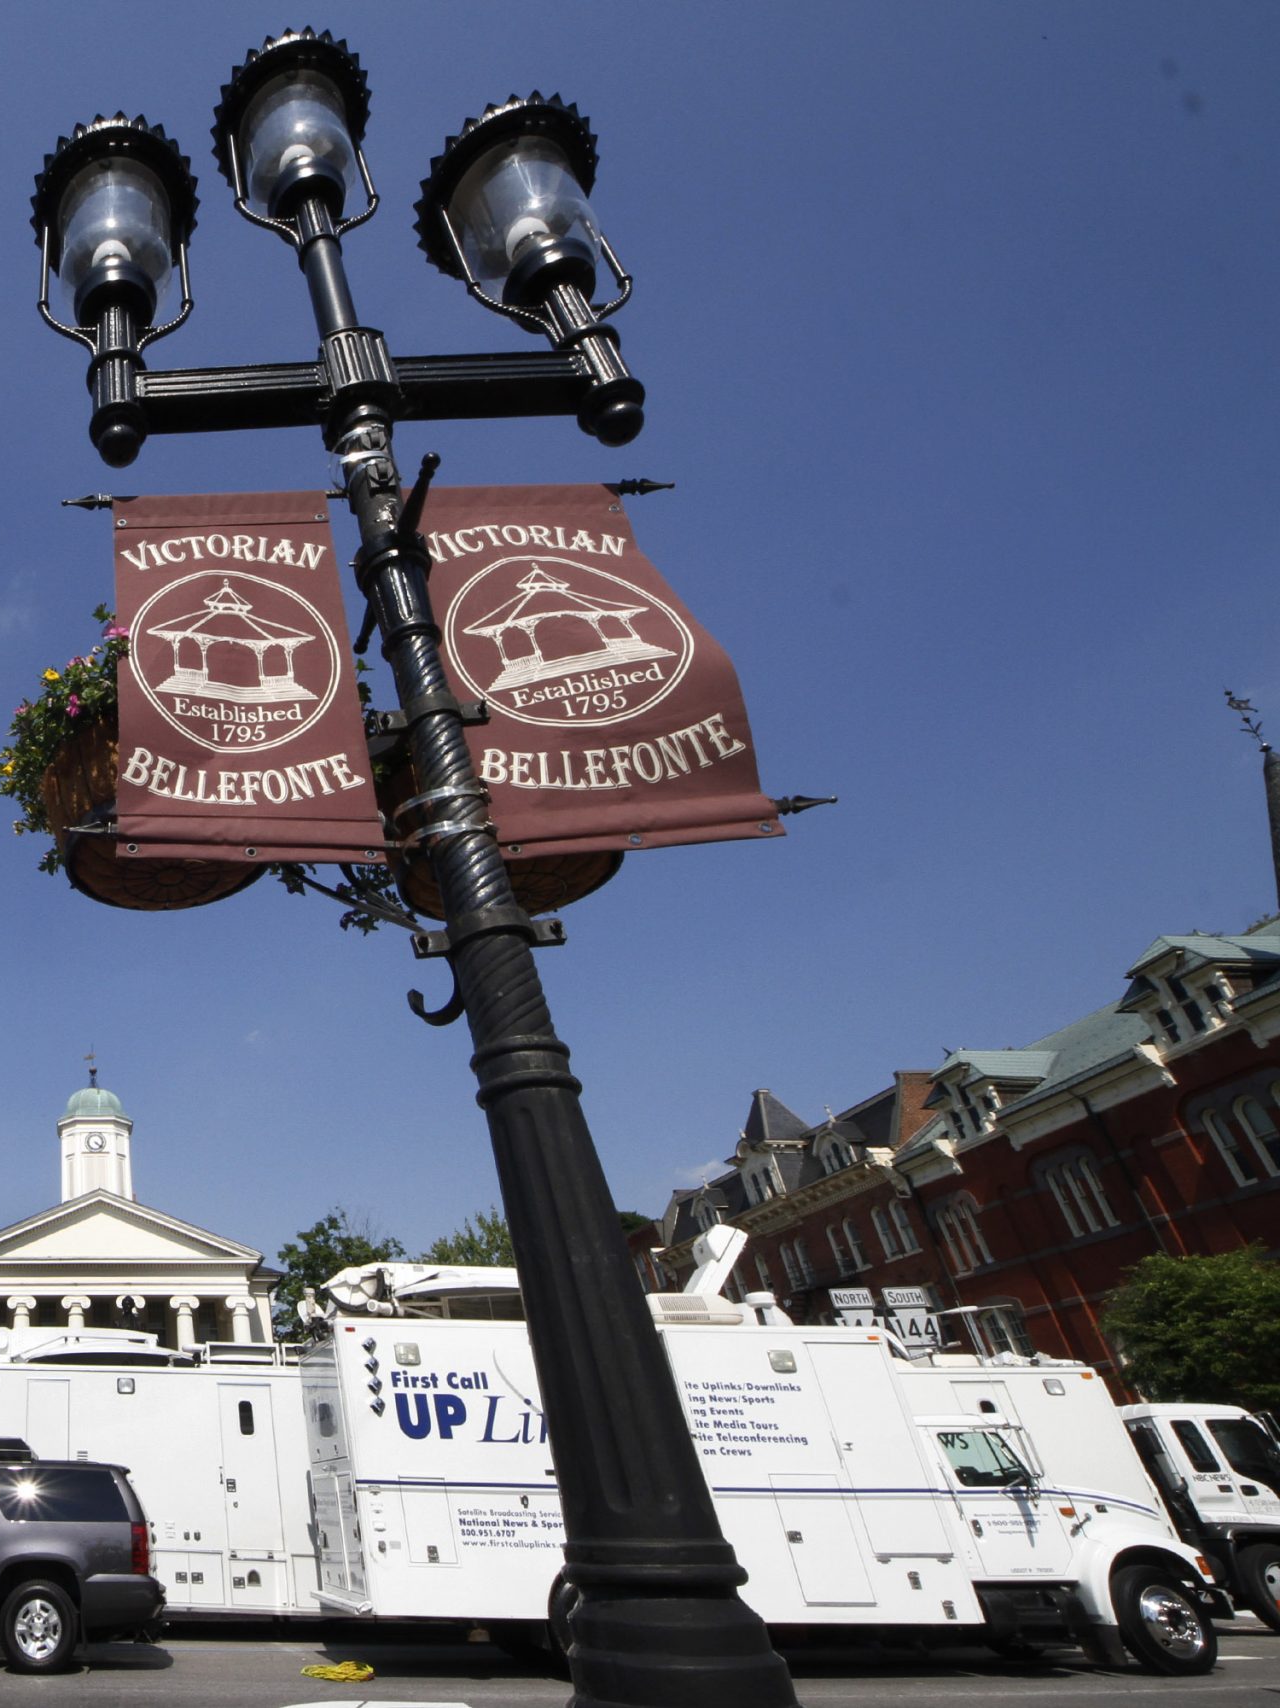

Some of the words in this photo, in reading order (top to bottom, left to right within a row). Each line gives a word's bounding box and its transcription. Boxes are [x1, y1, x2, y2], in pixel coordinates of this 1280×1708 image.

[120, 534, 327, 570] VICTORIAN
[428, 525, 626, 563] VICTORIAN
[510, 662, 665, 709] Established
[173, 697, 303, 723] Established
[561, 690, 627, 717] 1795
[211, 724, 267, 743] 1795
[479, 712, 746, 790] BELLEFONTE
[121, 747, 366, 805] BELLEFONTE
[833, 1293, 871, 1305] NORTH
[887, 1291, 926, 1304] SOUTH
[895, 1317, 938, 1339] 144
[391, 1370, 439, 1389] First
[446, 1372, 489, 1390] Call
[394, 1393, 467, 1440] UP
[709, 1407, 745, 1416] Events
[713, 1420, 747, 1430] Media
[749, 1421, 780, 1430] Tours
[715, 1433, 809, 1446] Teleconferencing
[719, 1447, 753, 1457] Crews
[458, 1518, 500, 1527] National
[502, 1519, 529, 1528] News
[531, 1520, 539, 1528] &
[541, 1520, 564, 1531] Spor
[460, 1528, 516, 1538] 800.951.6707
